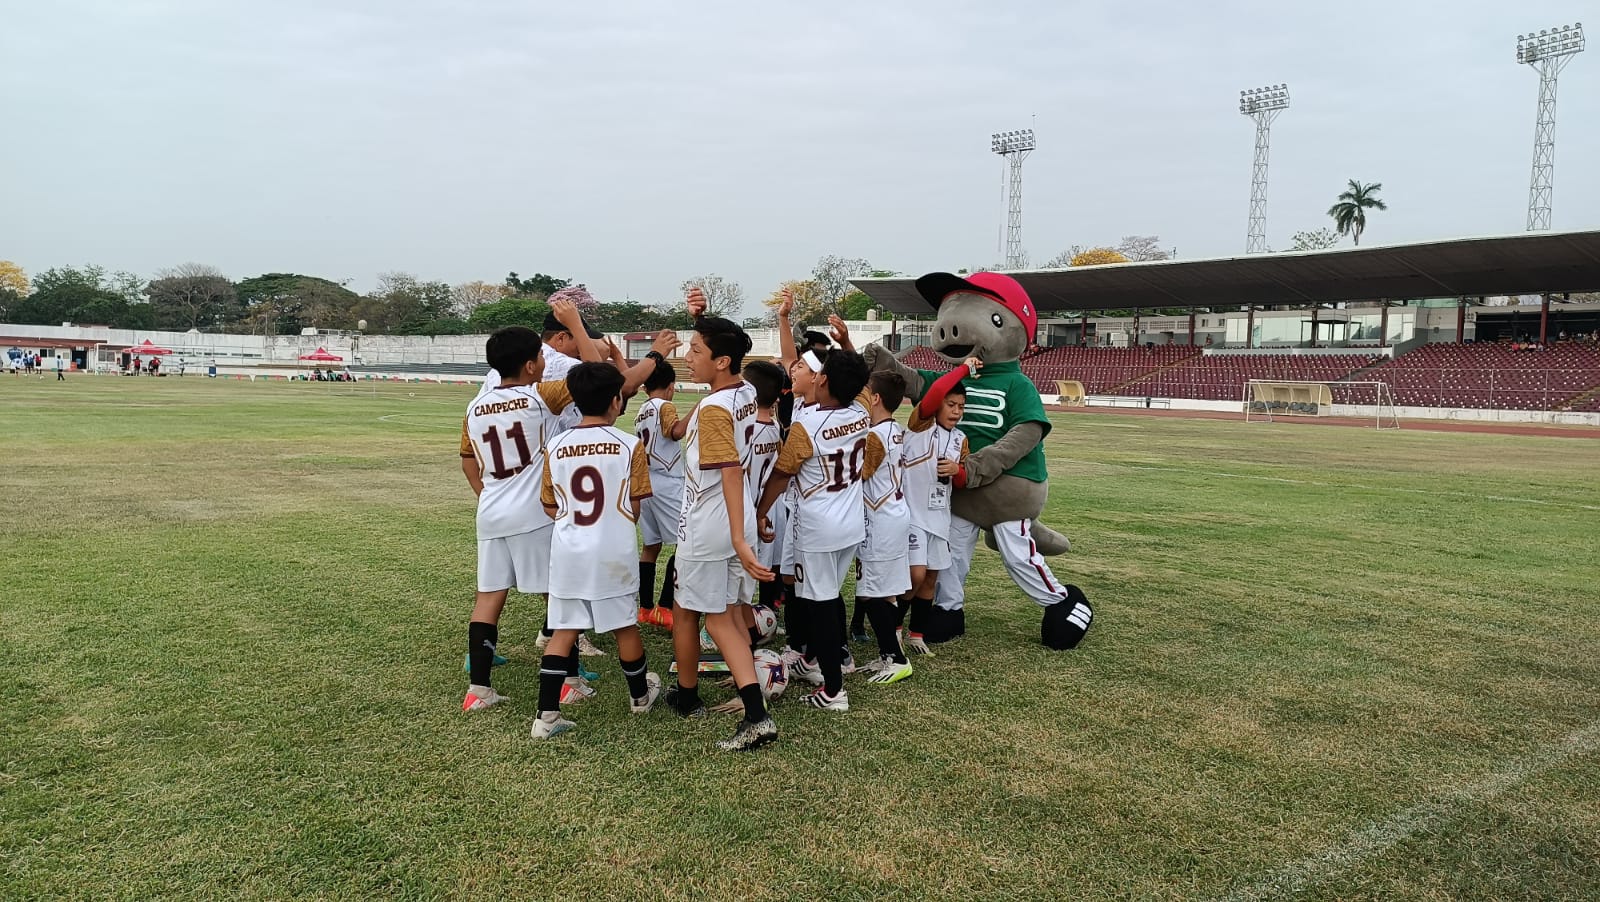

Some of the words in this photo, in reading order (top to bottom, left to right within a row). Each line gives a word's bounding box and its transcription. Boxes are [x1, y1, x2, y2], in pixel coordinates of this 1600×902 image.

[474, 398, 529, 417] CAMPECHE
[482, 421, 533, 480] 11
[556, 443, 621, 460] CAMPECHE
[826, 438, 867, 492] 10
[570, 465, 605, 526] 9
